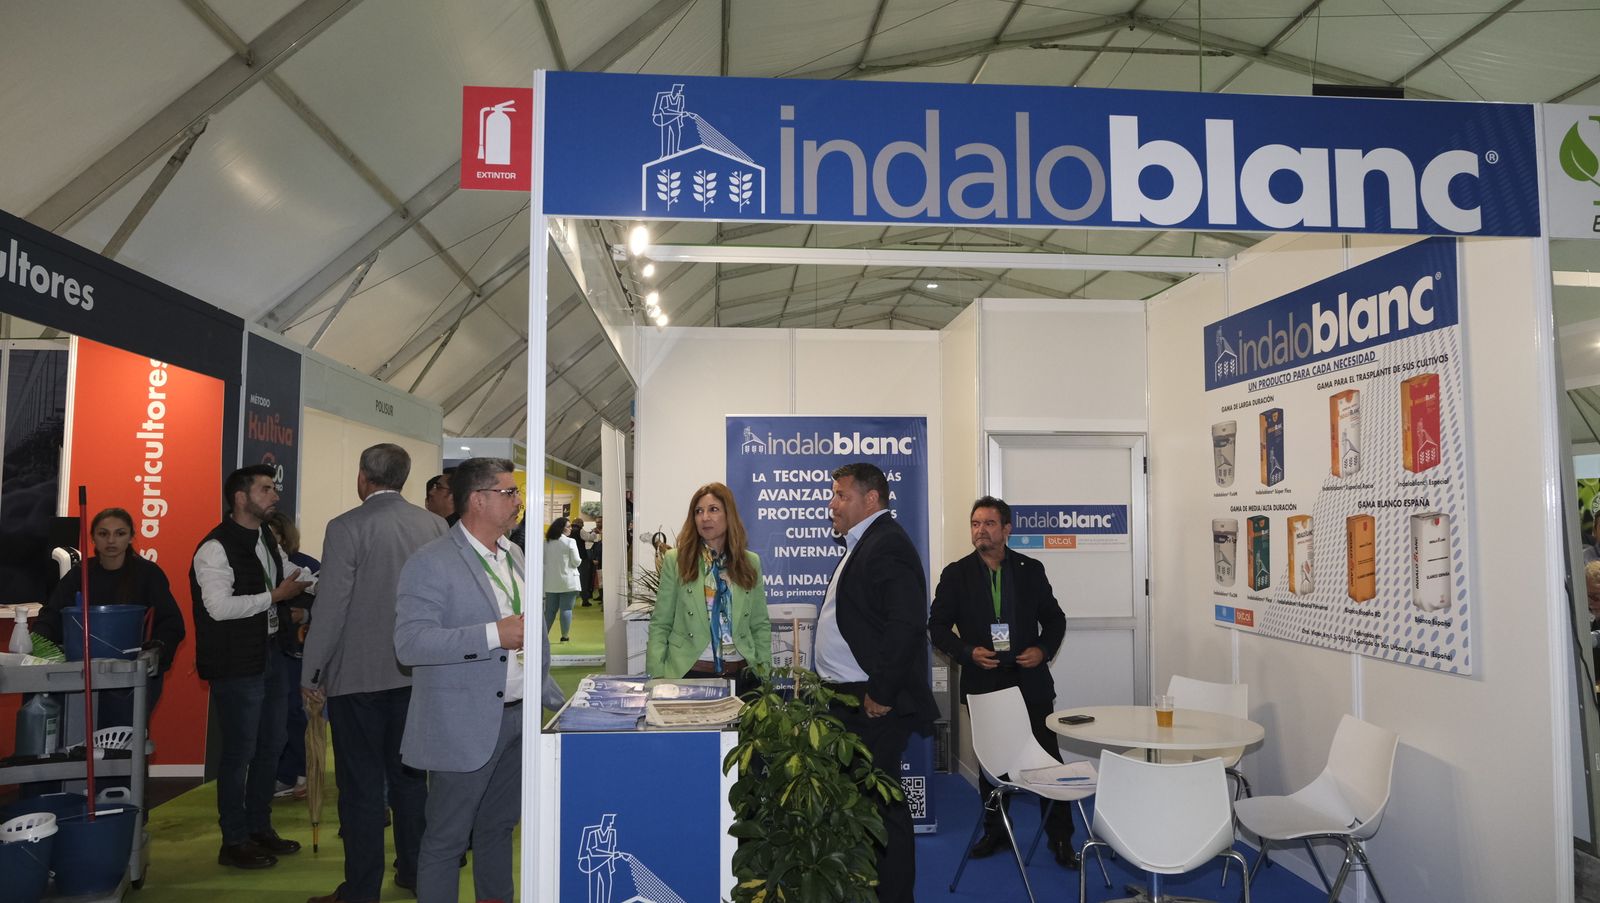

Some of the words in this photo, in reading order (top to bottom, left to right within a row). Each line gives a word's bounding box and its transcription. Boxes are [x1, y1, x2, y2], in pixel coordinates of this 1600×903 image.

[477, 171, 516, 179] EXTINTOR
[1248, 382, 1258, 391] UN
[1259, 373, 1292, 389] PRODUCTO
[1293, 369, 1311, 380] PARA
[1312, 363, 1331, 375] CADA
[1333, 351, 1376, 369] NECESIDAD
[1316, 380, 1333, 390] GAMA
[1334, 377, 1348, 388] PARA
[1356, 366, 1391, 381] TRASPLANTE
[1393, 365, 1400, 374] DE
[1402, 361, 1414, 371] SUS
[1416, 353, 1449, 369] CULTIVOS
[375, 400, 394, 416] POLISUR
[752, 473, 767, 482] LA
[773, 470, 834, 482] TECNOL
[758, 489, 833, 501] AVANZAD
[1377, 500, 1402, 508] BLANCO
[1403, 497, 1430, 507] ESPAÑA
[758, 509, 834, 520] PROTECCI
[786, 527, 848, 539] CULTIVO
[774, 547, 847, 557] INVERNAD
[771, 589, 784, 597] los
[786, 589, 826, 599] primeros
